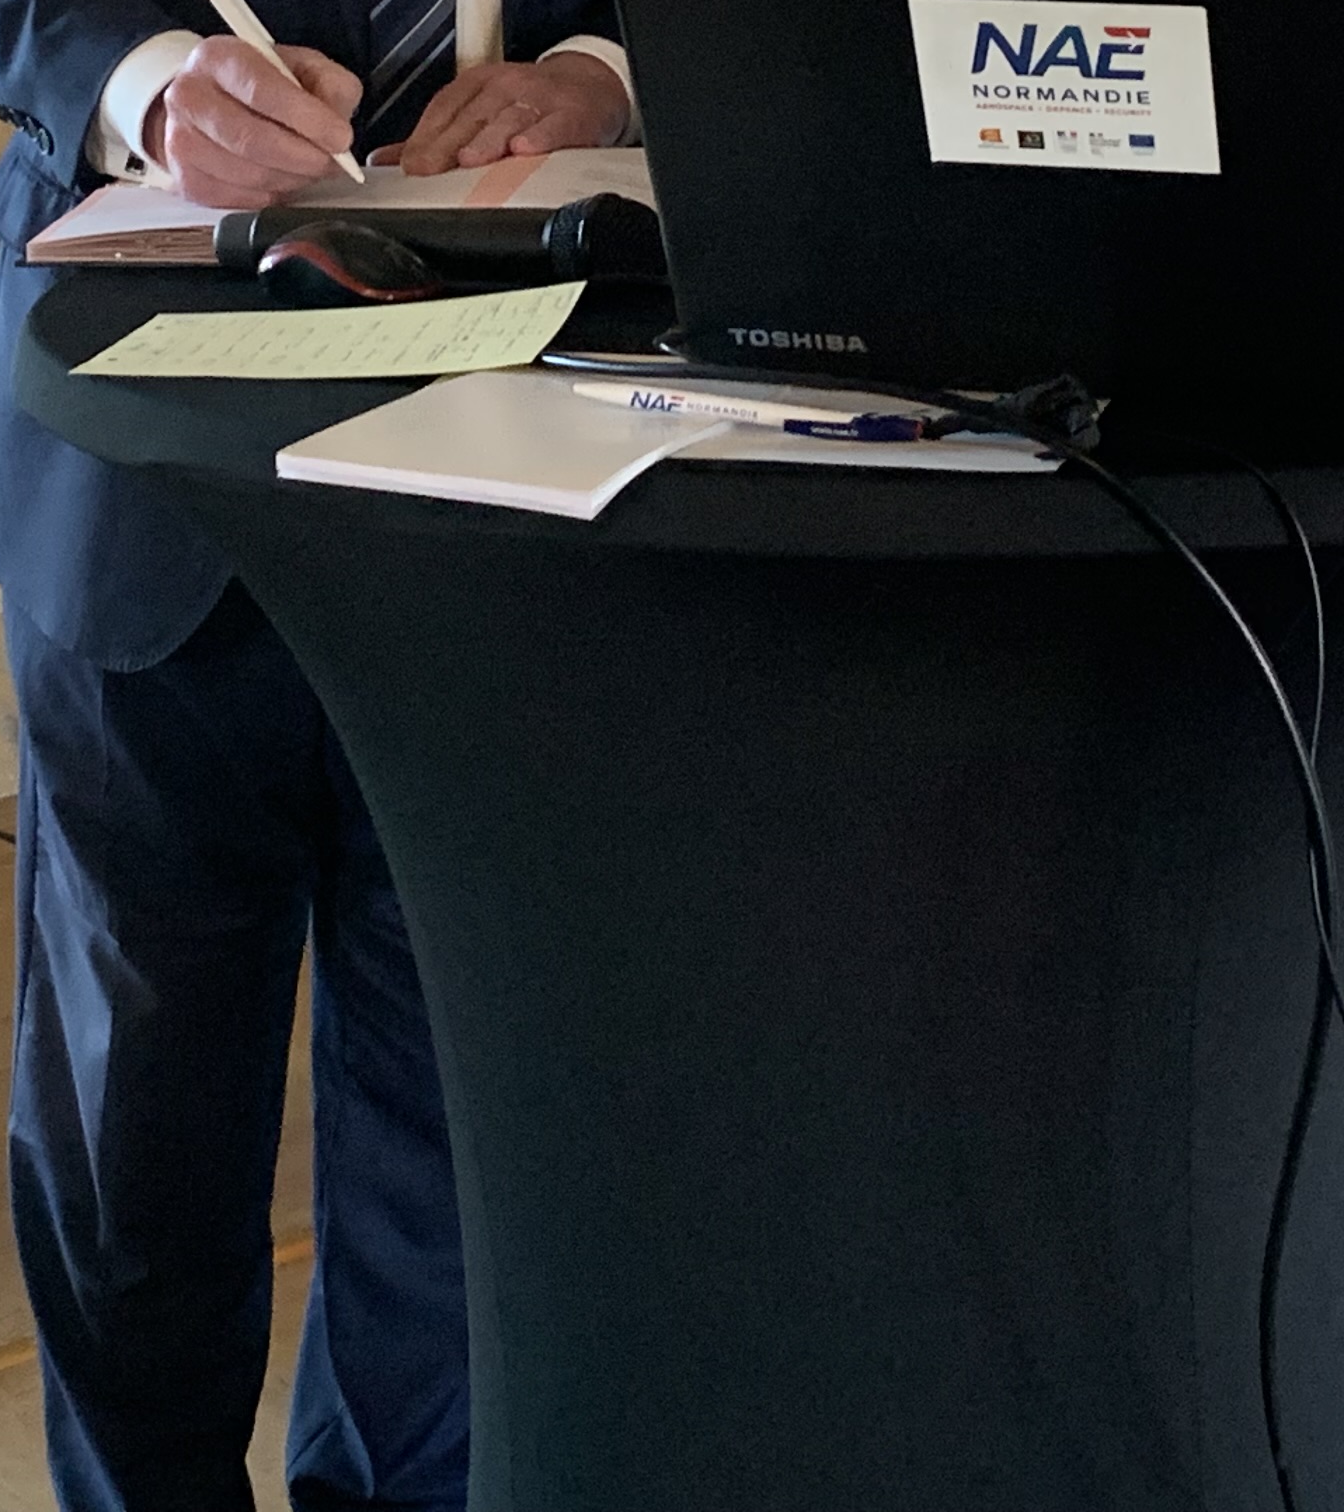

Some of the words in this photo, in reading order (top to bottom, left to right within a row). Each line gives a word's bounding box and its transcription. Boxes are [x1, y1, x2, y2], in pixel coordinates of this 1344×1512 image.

[970, 21, 1152, 81] NAE
[971, 83, 1153, 106] NORMANDIE
[726, 327, 869, 354] TOSHIBA
[686, 401, 759, 421] NORMANDIE
